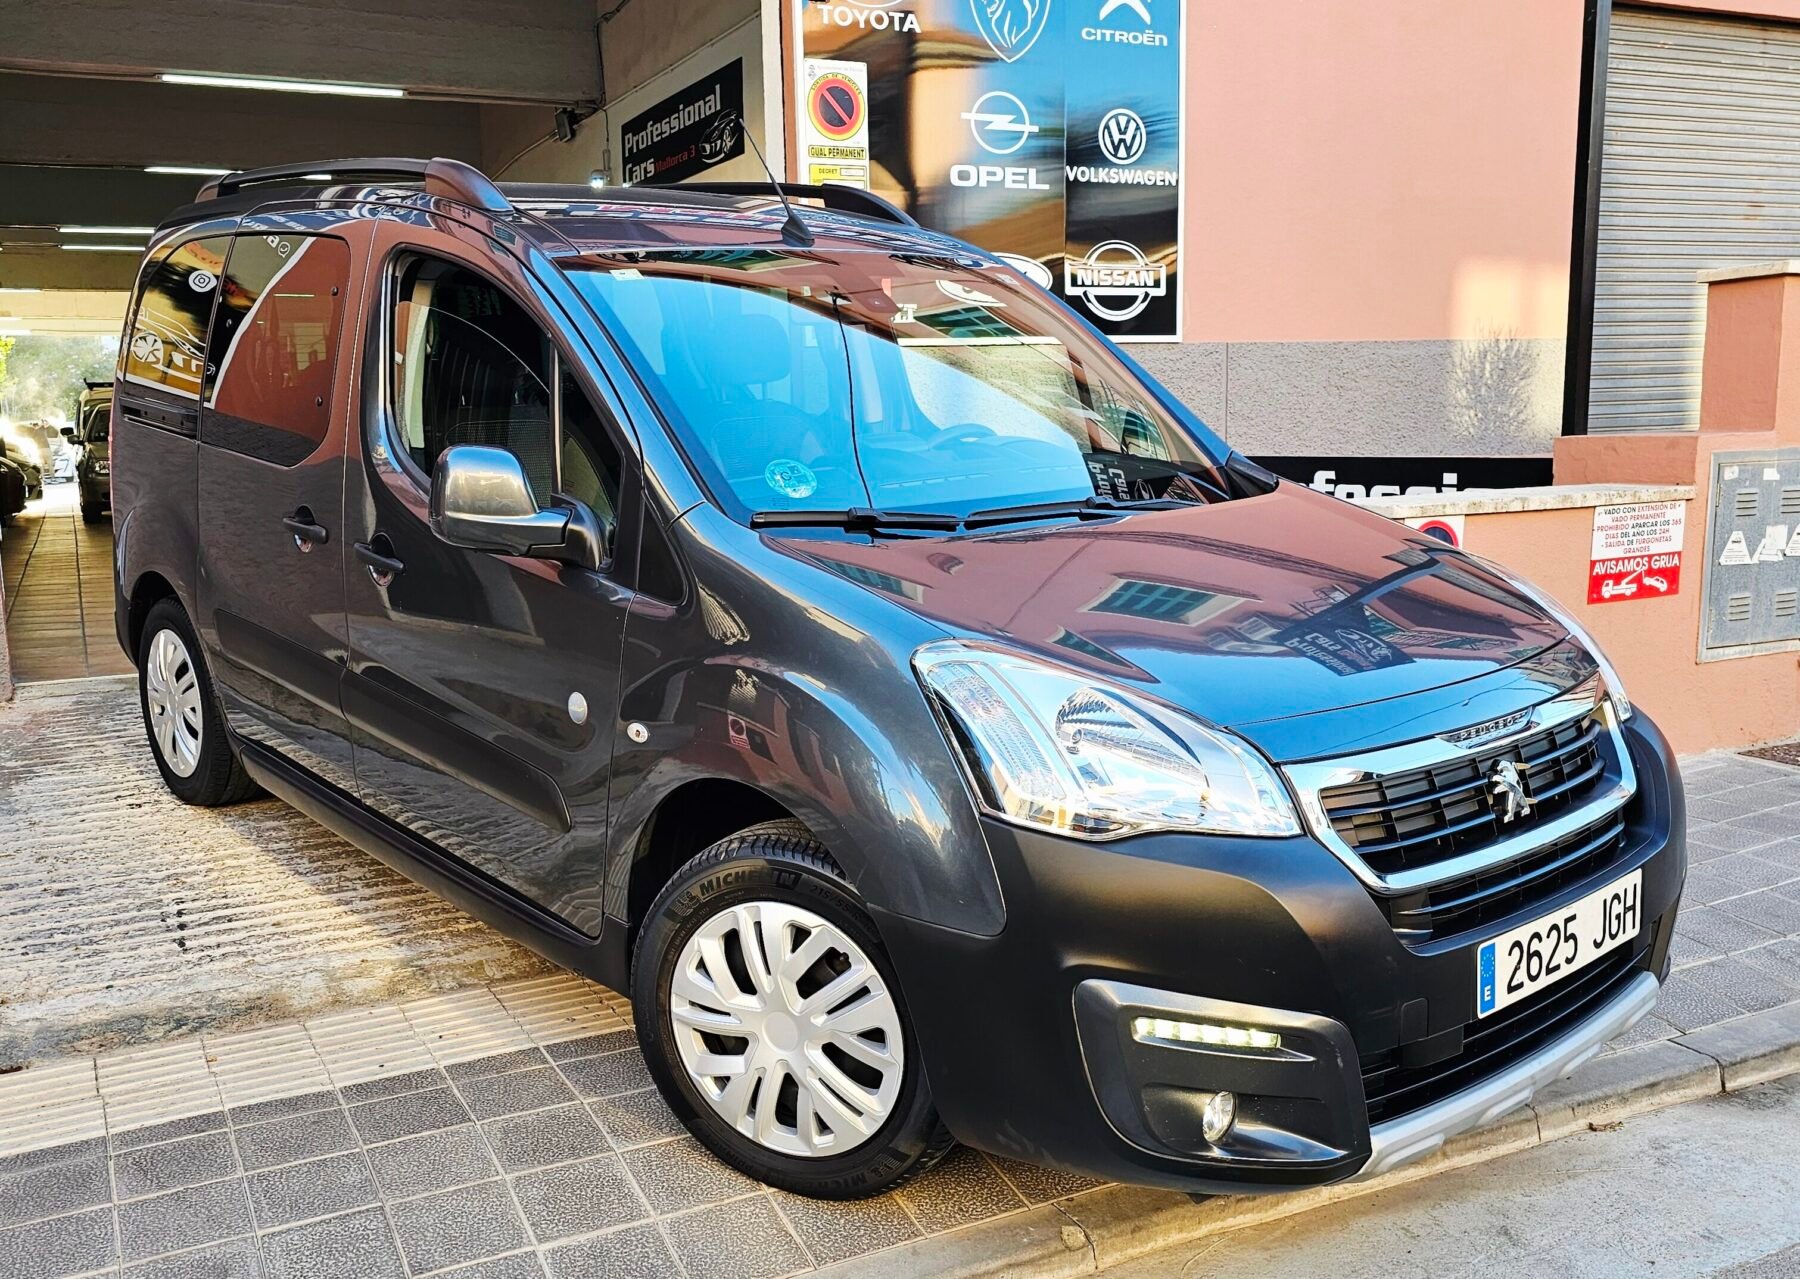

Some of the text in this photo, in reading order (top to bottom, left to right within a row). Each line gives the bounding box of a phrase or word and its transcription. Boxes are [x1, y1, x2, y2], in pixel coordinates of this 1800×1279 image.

[817, 4, 922, 33] TOYOTA
[624, 84, 721, 157] Professional
[811, 147, 865, 158] GUAL PERMANENT
[625, 145, 696, 186] Cars Mallorca 3
[950, 164, 1050, 190] OPEL
[1065, 165, 1178, 186] VOLKSWAGEN
[1077, 269, 1154, 287] NISSAN
[1604, 507, 1621, 515] VADO
[1622, 506, 1637, 514] CON
[1629, 512, 1666, 521] PERMANENTE
[1596, 524, 1630, 532] PROHIBIDO
[1631, 521, 1658, 529] APARCAR
[1659, 519, 1671, 527] LOS
[1604, 540, 1625, 548] SALIDA
[1635, 536, 1672, 545] FURGONETAS
[1605, 532, 1619, 540] DIAS
[1620, 531, 1630, 539] DEL
[1632, 529, 1645, 537] AÑO
[1623, 546, 1651, 555] GRANDES
[1593, 554, 1680, 575] AVISAMOS GRUA
[1507, 883, 1637, 994] 2625 JGH
[1484, 985, 1492, 1001] E
